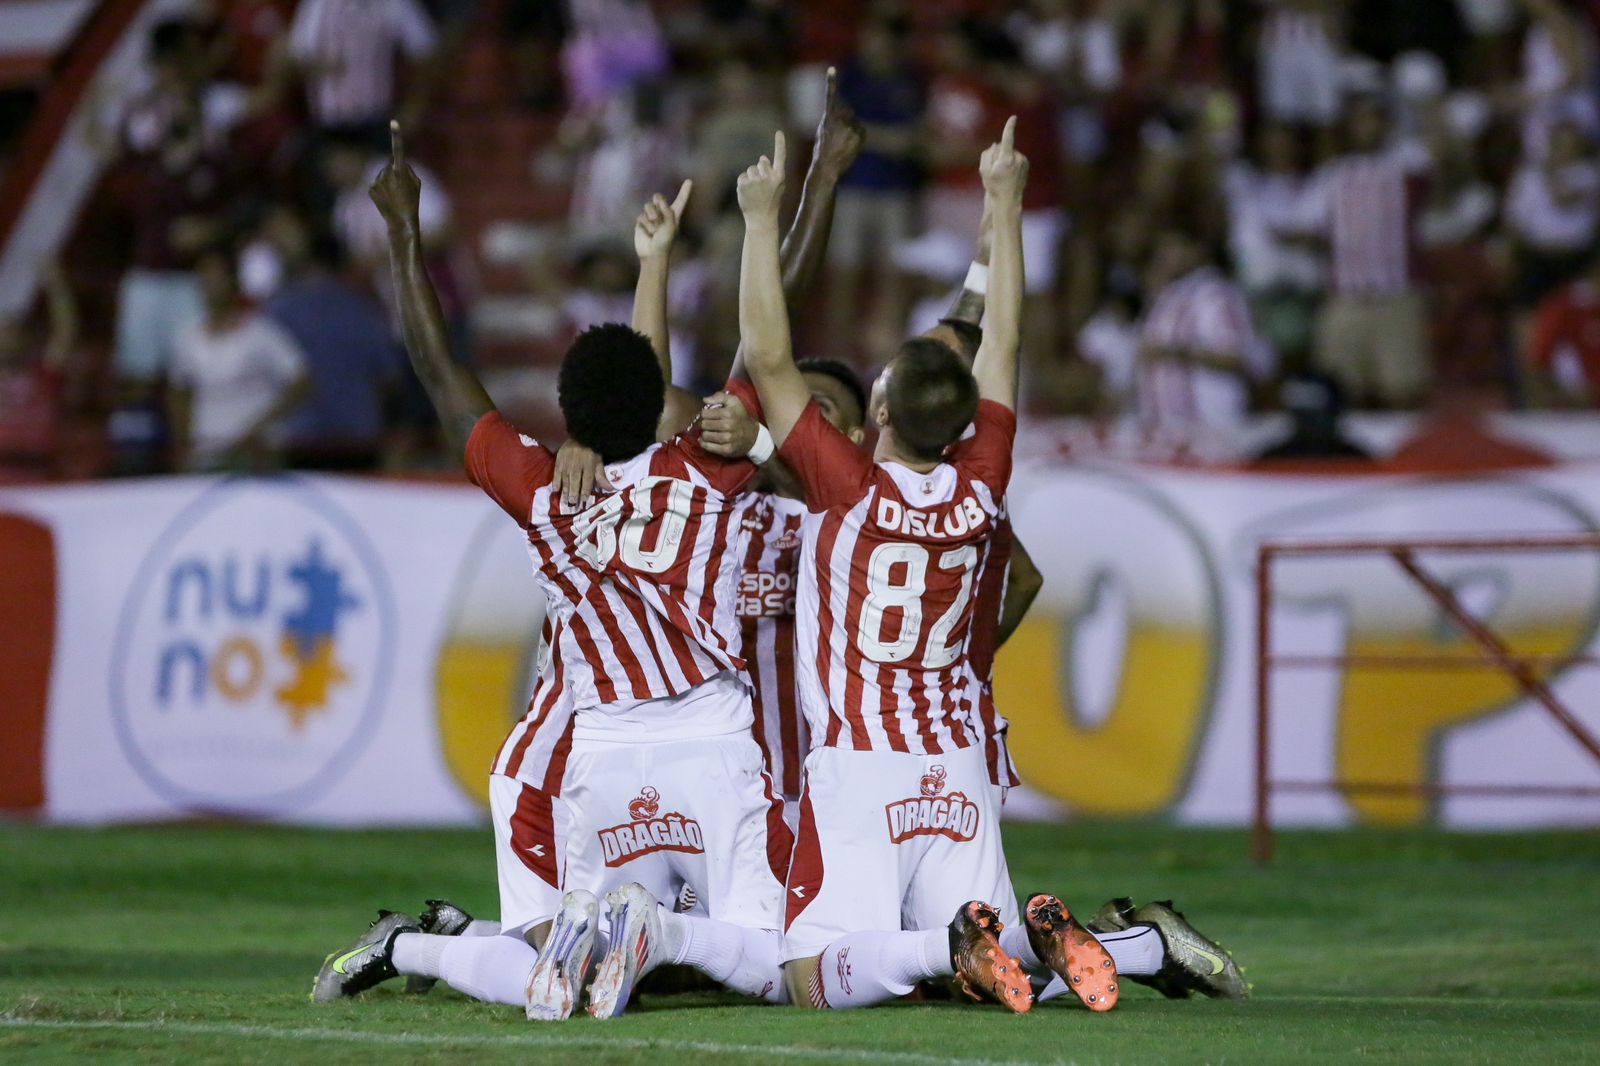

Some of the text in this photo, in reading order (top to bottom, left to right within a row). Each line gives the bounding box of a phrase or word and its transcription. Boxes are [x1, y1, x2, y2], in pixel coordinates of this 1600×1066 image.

[876, 496, 986, 538] DISLUB
[165, 552, 268, 622] nu
[857, 542, 978, 669] 82
[156, 634, 265, 708] no
[600, 815, 703, 863] DRAGÃO
[888, 794, 978, 840] DRAGÃO
